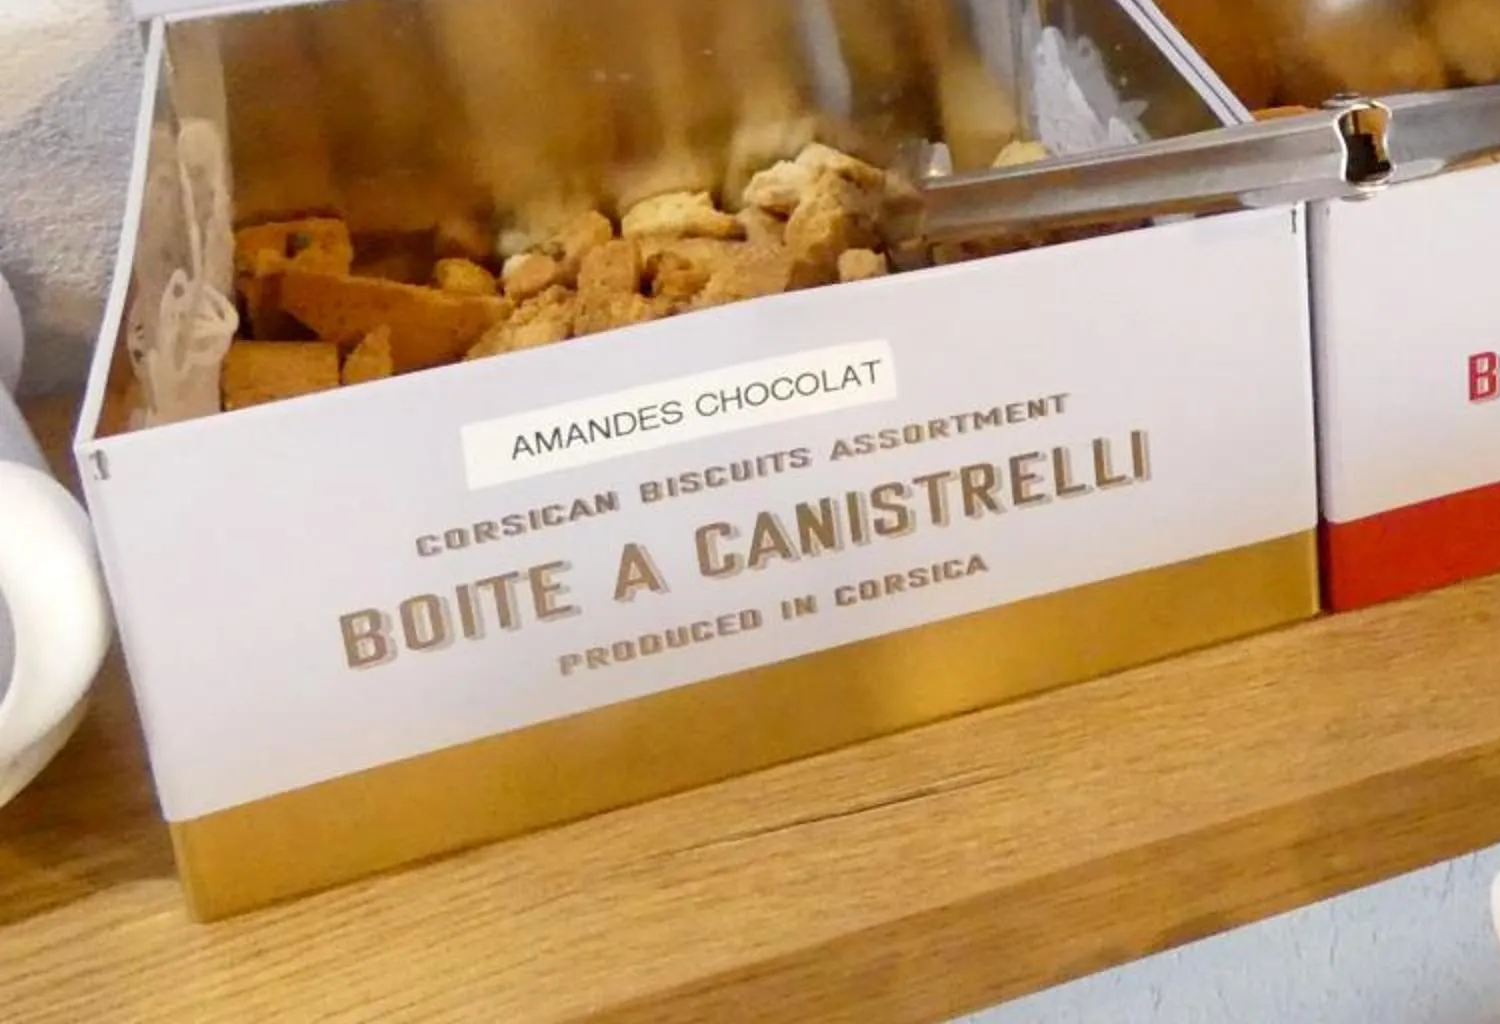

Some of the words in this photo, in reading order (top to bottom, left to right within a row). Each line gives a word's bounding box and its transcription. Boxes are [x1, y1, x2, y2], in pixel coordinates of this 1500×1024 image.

[415, 490, 620, 558] CORSICAN
[639, 446, 813, 504] BISCUITS
[829, 392, 1070, 462] ASSORTMENT
[510, 400, 683, 460] AMANDES
[695, 359, 884, 417] CHOCOLAT
[338, 558, 580, 671] BOITE
[613, 541, 669, 601] A
[694, 429, 1154, 580] CANISTRELLI
[558, 608, 762, 677] PRODUCED
[781, 594, 817, 622] IN
[835, 553, 989, 610] CORSICA
